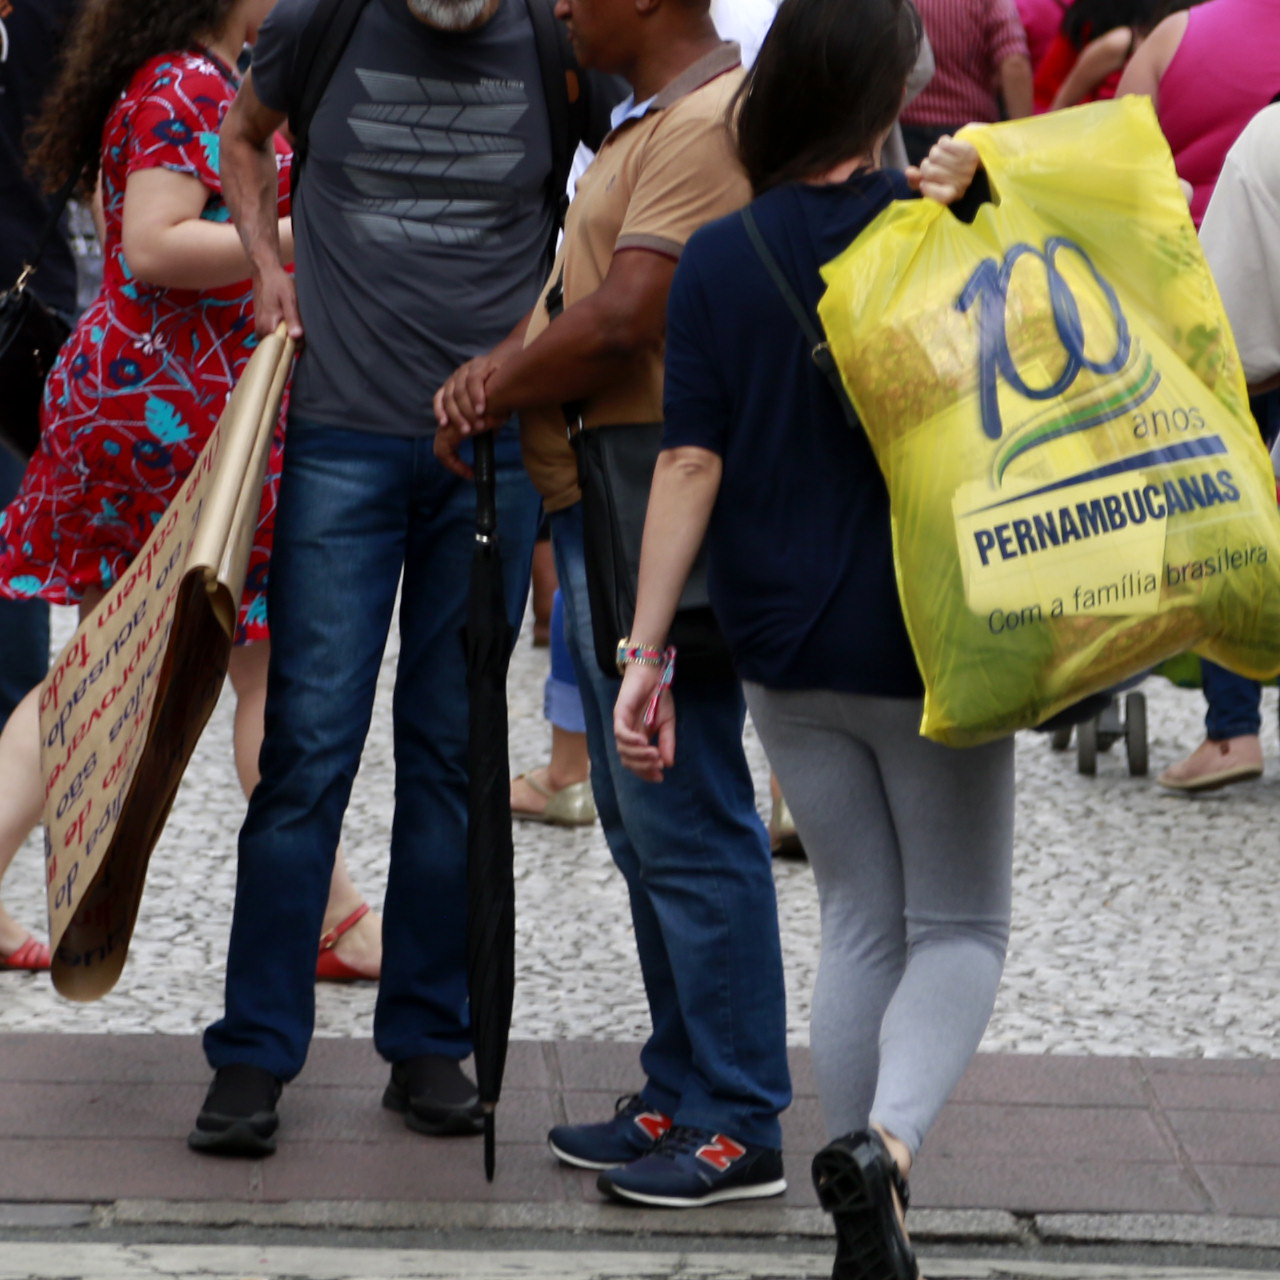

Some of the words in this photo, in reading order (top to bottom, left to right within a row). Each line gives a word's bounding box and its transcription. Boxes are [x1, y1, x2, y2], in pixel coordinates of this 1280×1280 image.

[953, 234, 1134, 440] 100
[1132, 402, 1207, 440] anos
[972, 468, 1242, 568] PERNAMBUCANAS
[98, 508, 180, 630] cabem
[987, 599, 1043, 636] Com
[1050, 598, 1065, 619] a
[1072, 569, 1159, 612] família
[1164, 540, 1270, 590] brasileira
[56, 751, 99, 820] são
[64, 798, 93, 847] de
